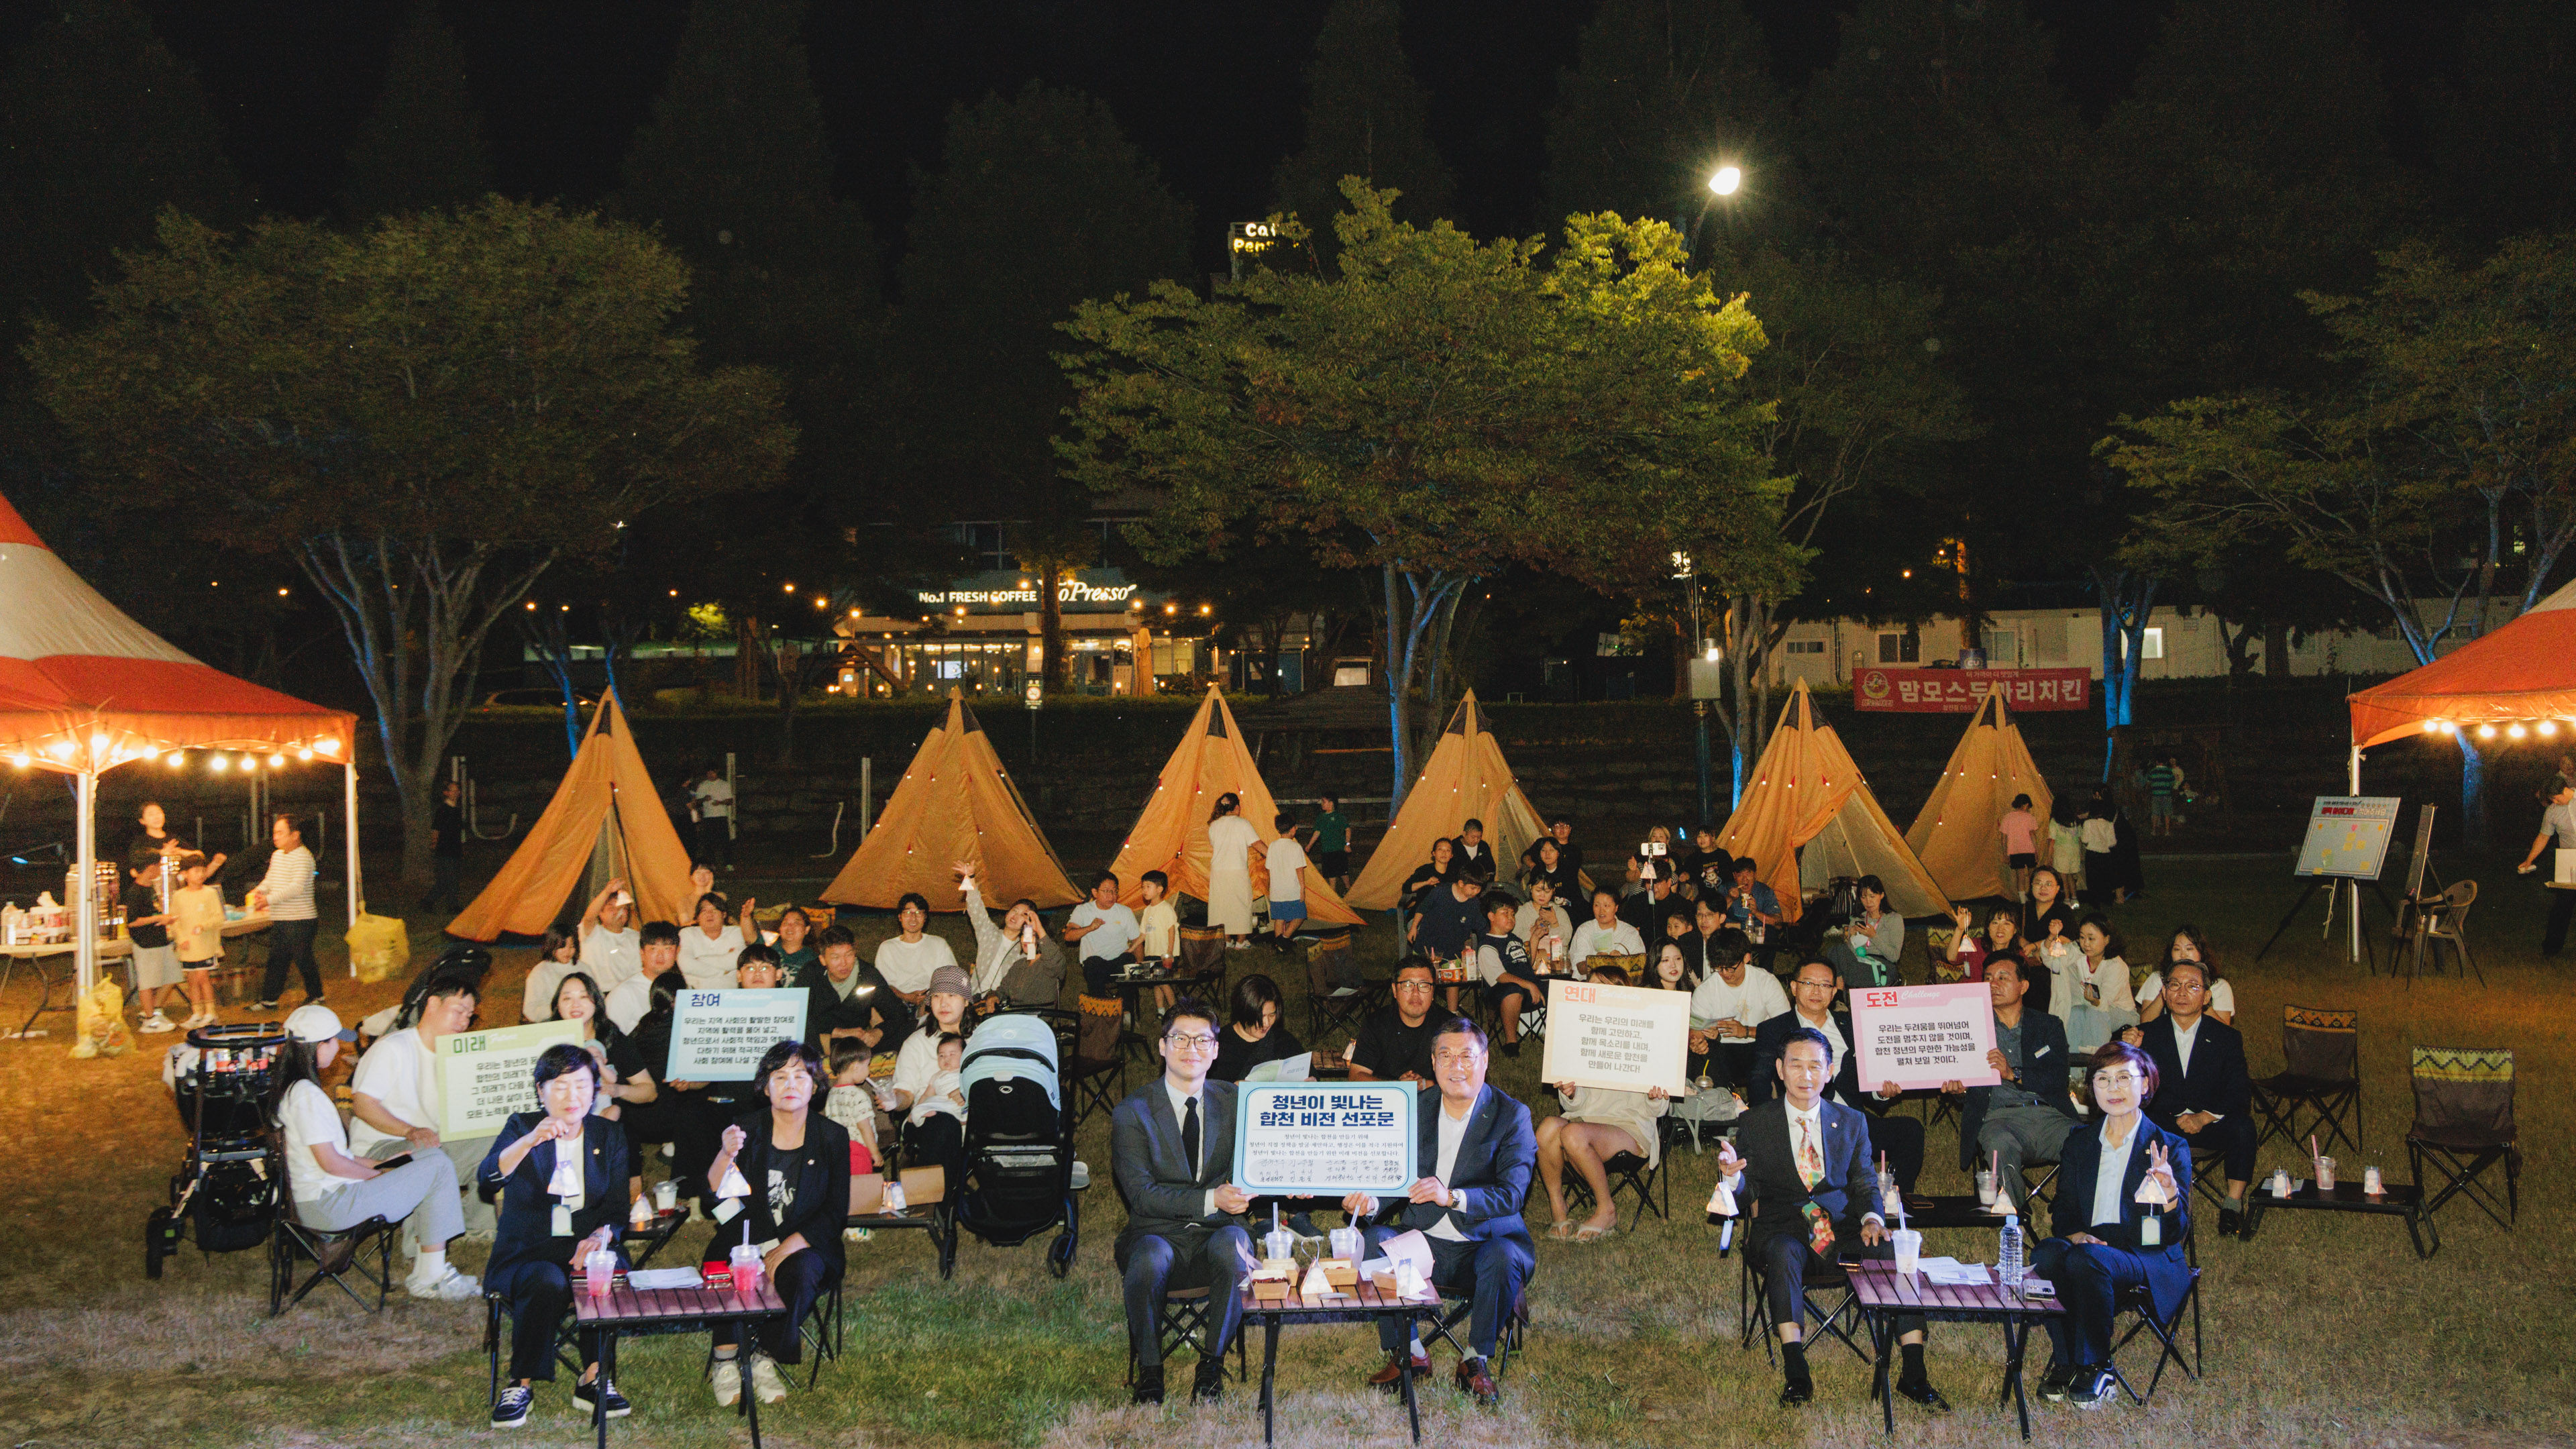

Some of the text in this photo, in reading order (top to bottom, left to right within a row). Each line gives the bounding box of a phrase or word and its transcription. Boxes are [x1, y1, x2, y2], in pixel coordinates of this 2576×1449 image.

[918, 592, 944, 603] No.1
[949, 592, 988, 602] FRESH
[991, 591, 1037, 602] COFFEE
[691, 994, 720, 1007] 참여
[1564, 985, 1597, 1004] 연대
[1866, 991, 1898, 1008] 도전
[1901, 989, 1941, 1000] Challenge
[1578, 1014, 1654, 1029] 우리는 우리의 미래를
[1879, 1021, 1969, 1032] 우리는 두려움을 뛰어넘어
[1591, 1026, 1642, 1040] 함께 고민하고,
[1878, 1032, 1973, 1044] 도전을 멈추지 않을 것이며,
[453, 1034, 486, 1053] 미래
[1581, 1036, 1651, 1052] 함께 목소리를 내며,
[1875, 1043, 1976, 1055] 합천 청년의 무한한 가능성을
[1580, 1048, 1648, 1063] 함께 새로운 합천을
[1896, 1055, 1959, 1066] 펼쳐 보일 것이다.
[476, 1062, 500, 1071] 우리는
[1588, 1061, 1640, 1073] 만들어 나간다!
[471, 1086, 480, 1095] 그
[1273, 1095, 1383, 1110] 청년이 빛나는
[1260, 1112, 1395, 1127] 합천 비전 선포문
